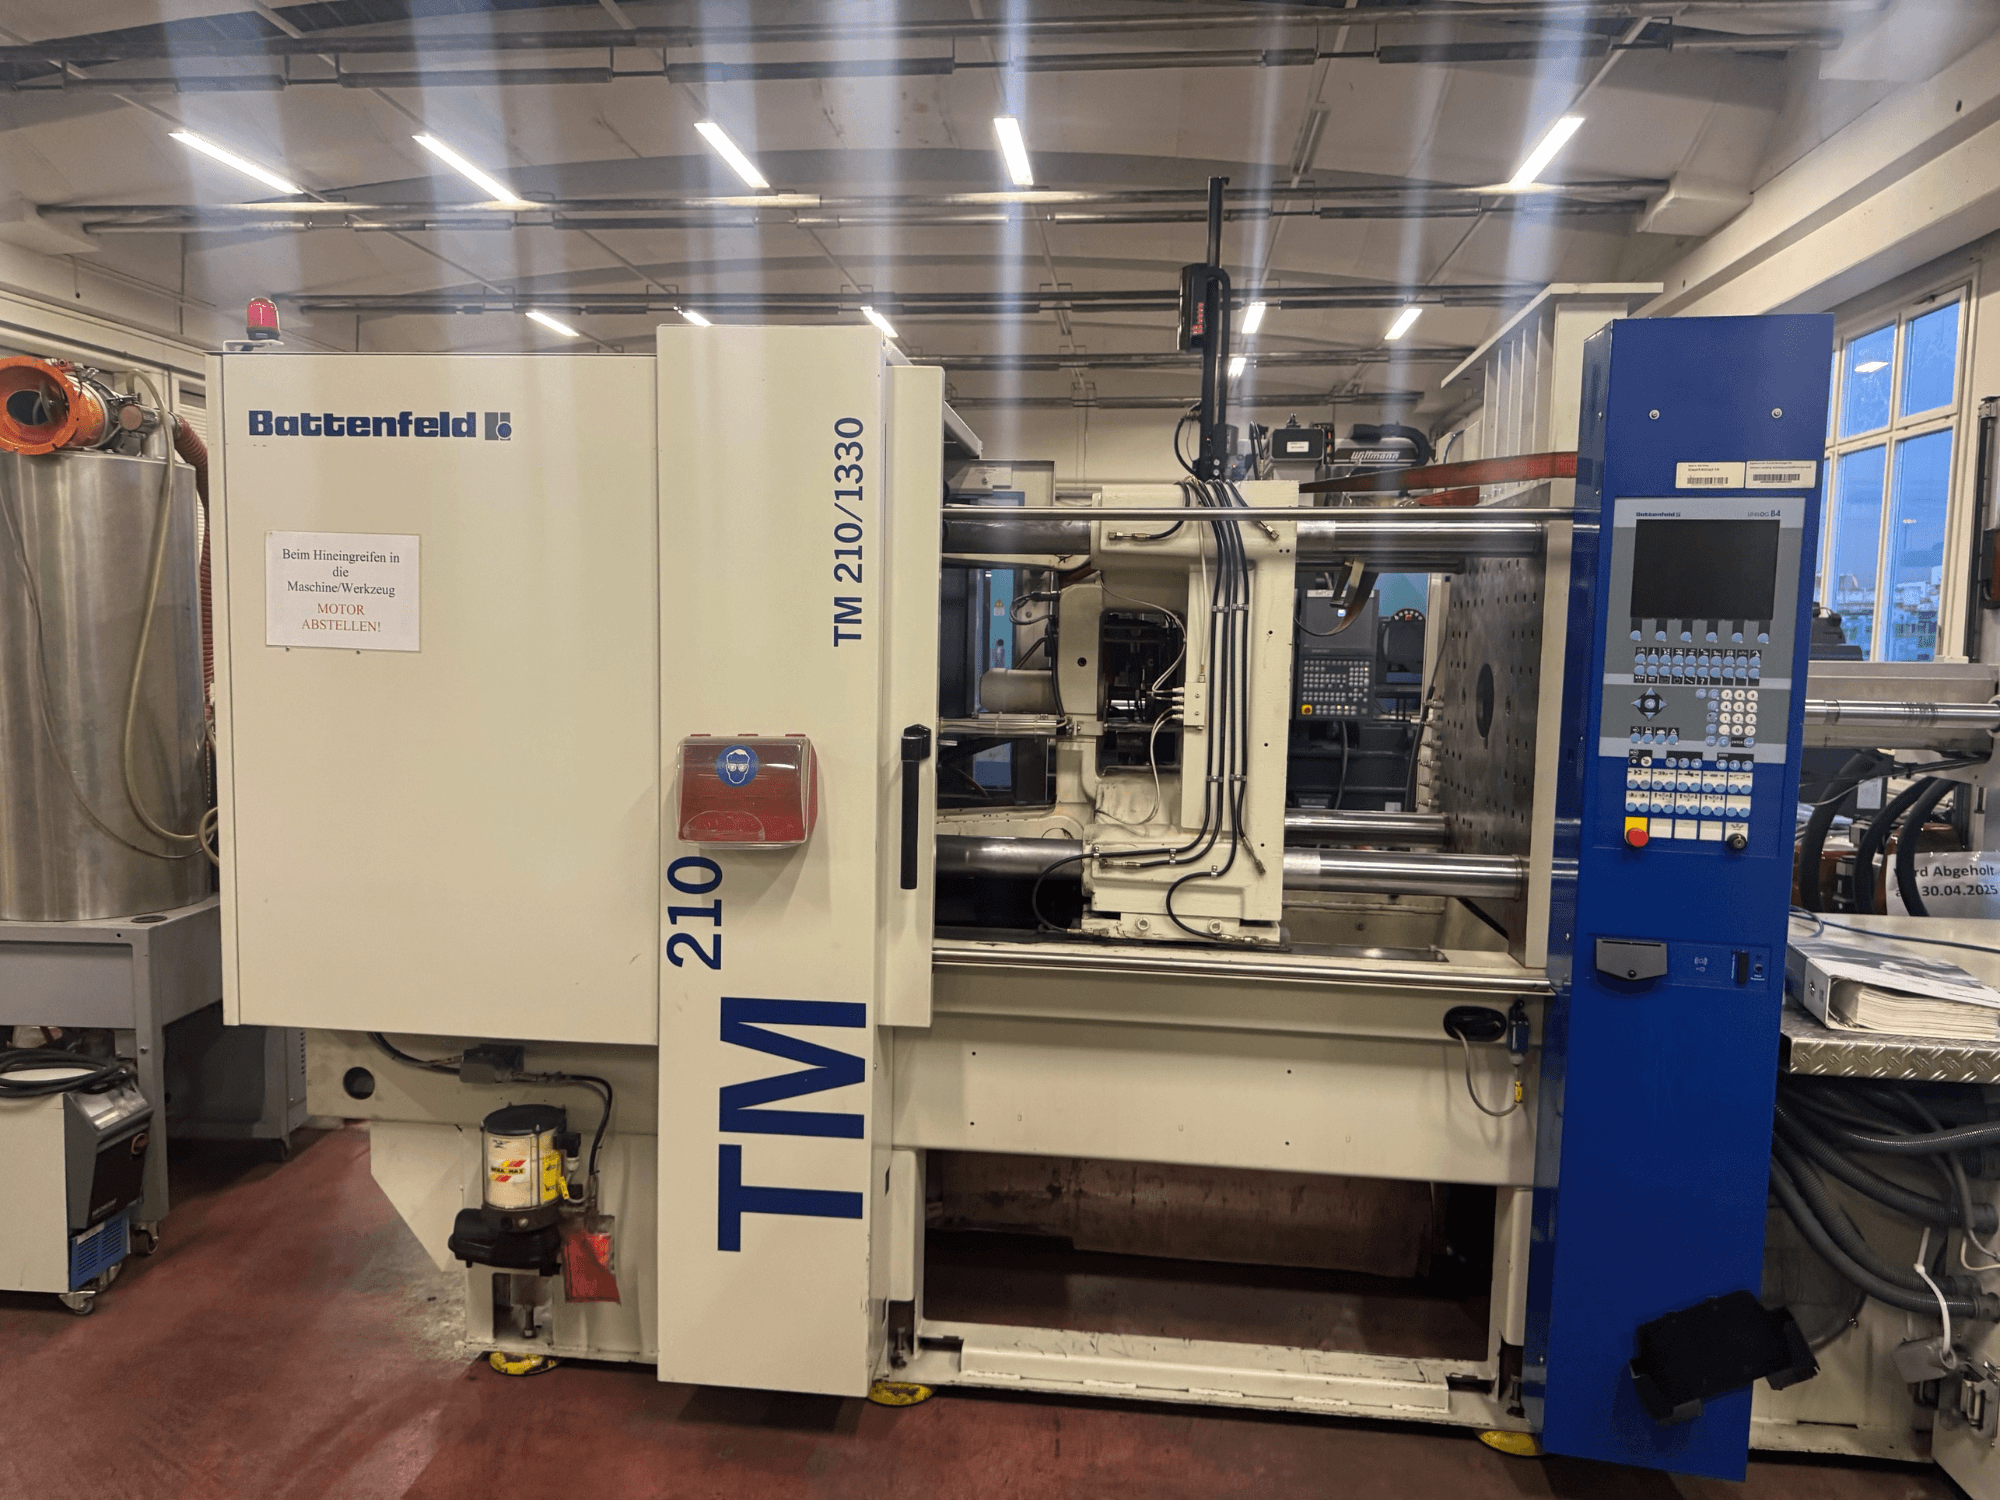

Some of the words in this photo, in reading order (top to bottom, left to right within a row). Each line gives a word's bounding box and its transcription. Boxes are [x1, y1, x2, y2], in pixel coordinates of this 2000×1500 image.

[249, 410, 477, 437] Battenfeld
[833, 417, 863, 585] 210/1330
[282, 548, 310, 561] Beim
[313, 549, 387, 565] Hineingreifen
[390, 552, 400, 563] in
[332, 567, 349, 578] die
[286, 580, 396, 598] Maschine/Werkzeug
[317, 603, 365, 616] MOTOR
[301, 618, 381, 633] ABSTELLEN!
[833, 597, 863, 647] TM
[1933, 865, 1995, 879] Abgeholt
[1921, 884, 1998, 897] 30.04.2025
[667, 856, 722, 970] 210
[718, 997, 867, 1252] TM
